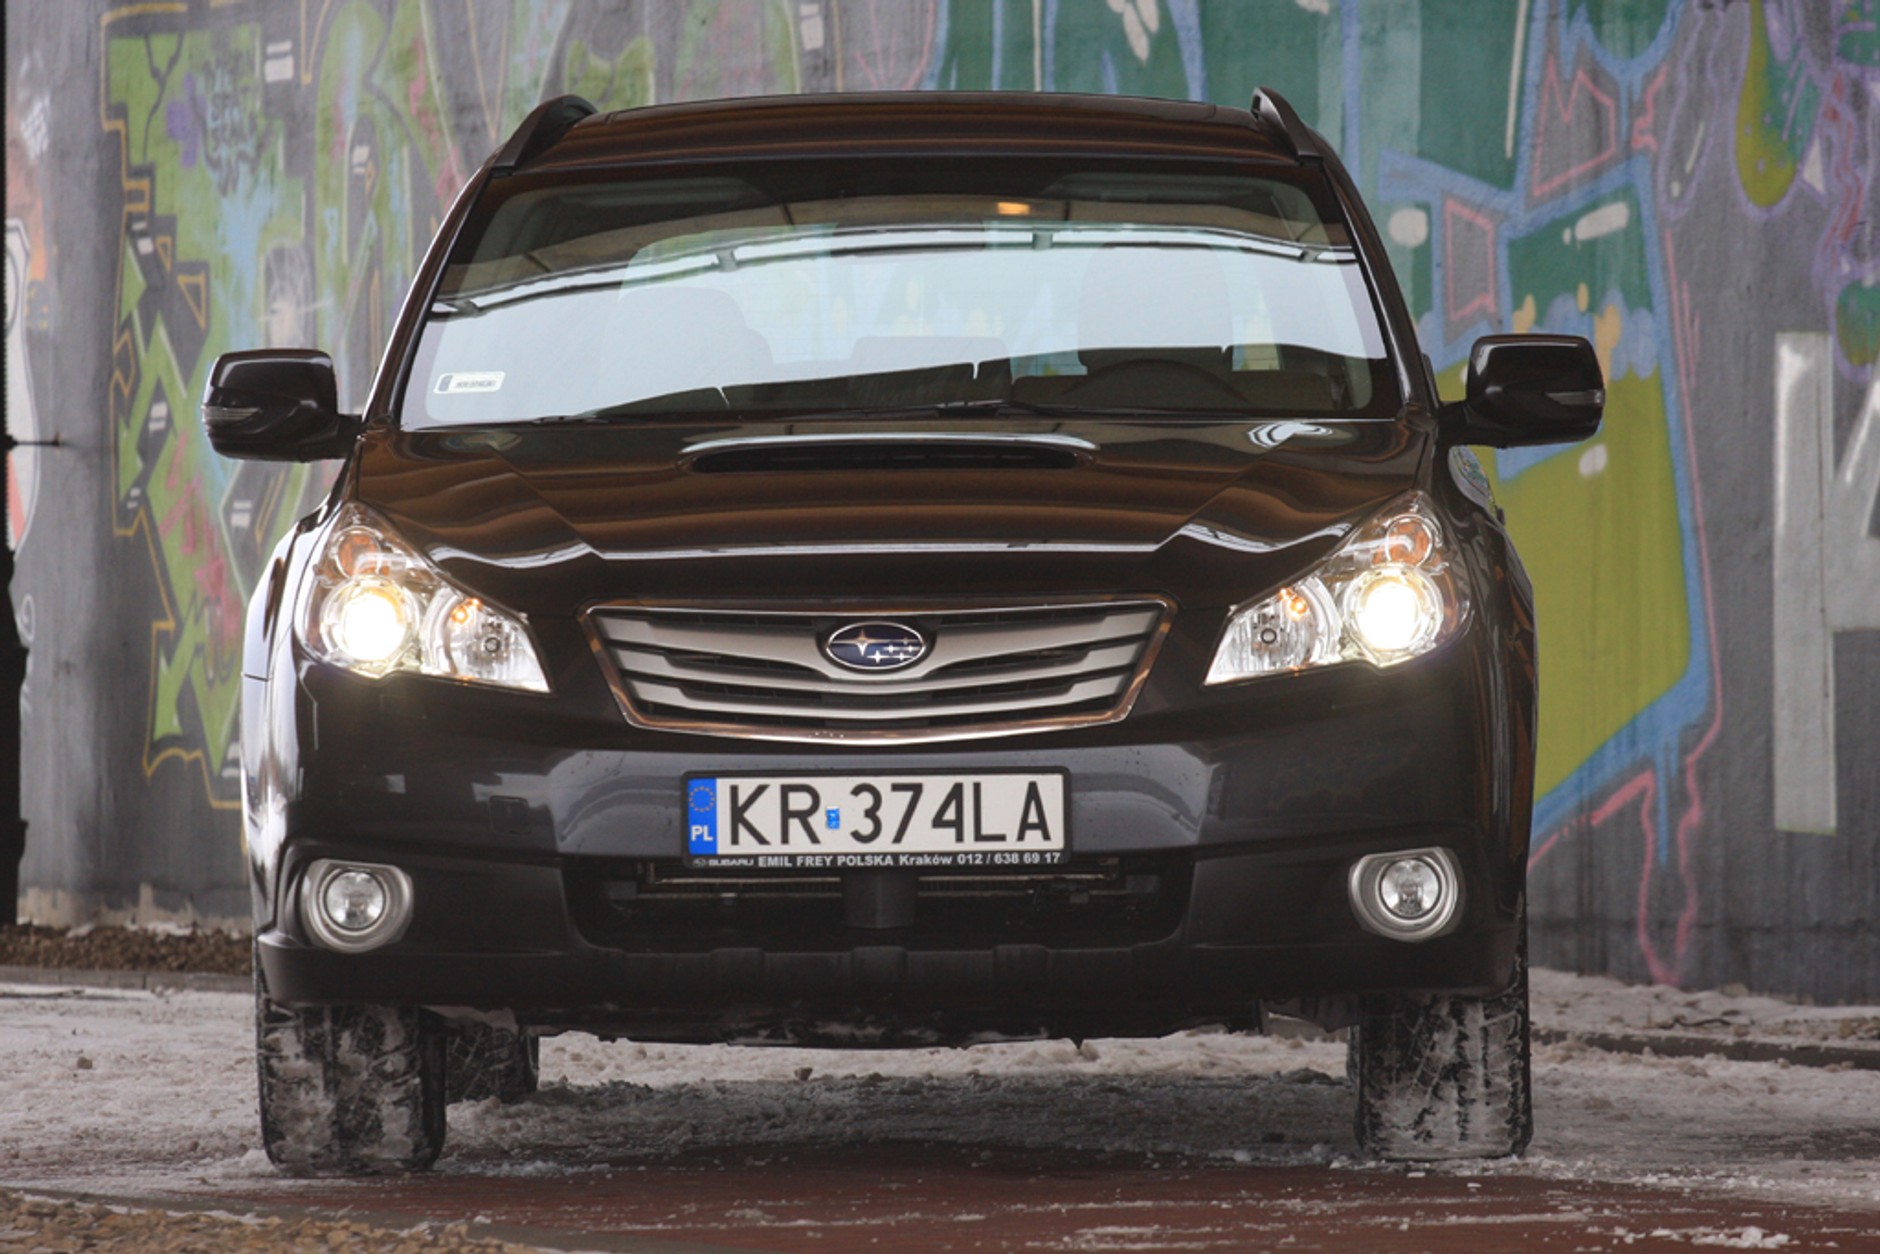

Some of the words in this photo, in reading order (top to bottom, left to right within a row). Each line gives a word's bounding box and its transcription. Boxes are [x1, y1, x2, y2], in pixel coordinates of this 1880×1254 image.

[729, 784, 822, 846] KR
[849, 780, 1052, 844] 374LA
[691, 825, 714, 842] PL
[758, 856, 793, 868] EMIL
[796, 855, 834, 867] FREY
[837, 854, 894, 867] POLSKA
[899, 853, 953, 866] Kraków
[957, 853, 983, 865] 012
[993, 852, 1020, 864] 638
[1044, 852, 1061, 864] 17
